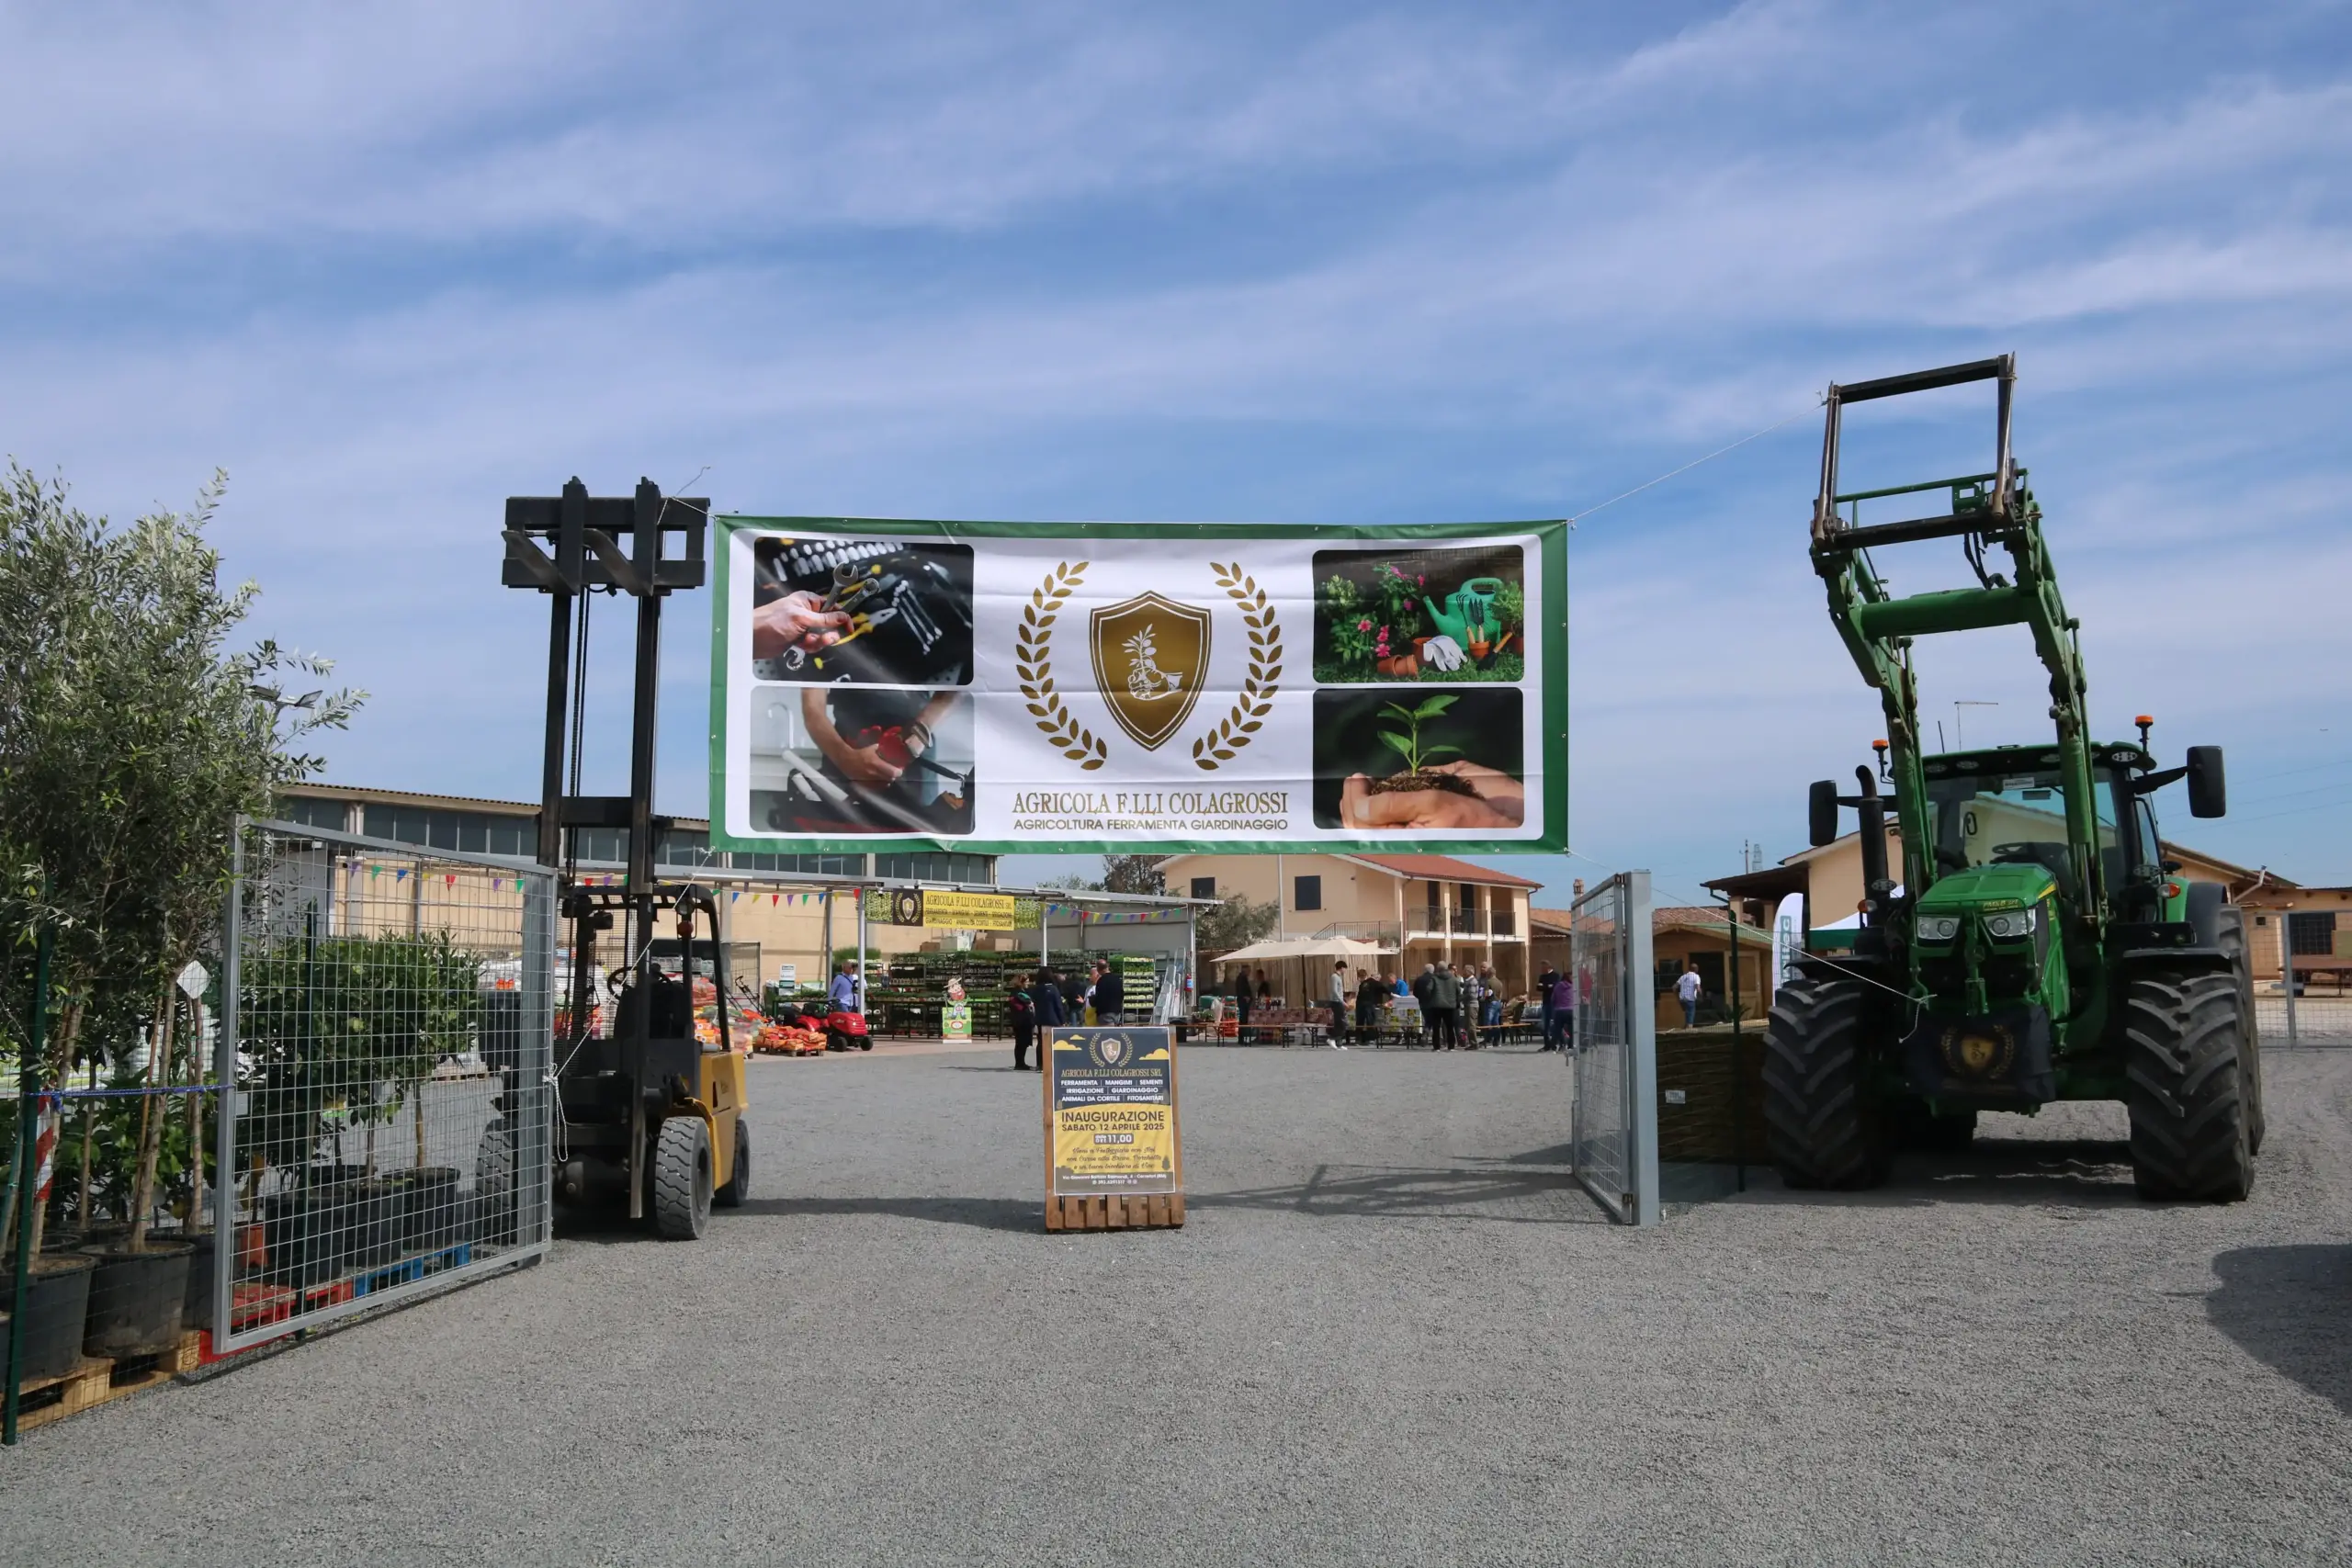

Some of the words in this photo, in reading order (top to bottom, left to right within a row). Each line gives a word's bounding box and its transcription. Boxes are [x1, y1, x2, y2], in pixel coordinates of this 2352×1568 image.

[1012, 792, 1112, 814] AGRICOLA
[1116, 793, 1164, 815] F.LLI
[1169, 792, 1289, 815] COLAGROSSI
[1013, 819, 1103, 830] AGRICOLTURA
[1108, 819, 1187, 830] FERRAMENTA
[1191, 819, 1288, 830] GIARDINAGGIO
[926, 895, 954, 906] AGRICOLA
[970, 897, 1004, 908] COLAGROSSI
[1061, 1068, 1092, 1077] AGRICOLA
[1094, 1069, 1110, 1077] F.LLI
[1111, 1068, 1149, 1077] COLAGROSSI
[1150, 1068, 1162, 1077] SRL
[1061, 1111, 1164, 1122] INAUGURAZIONE
[1062, 1123, 1096, 1132] SABATO
[1143, 1122, 1165, 1131] 2025
[1107, 1134, 1132, 1144] 11,00
